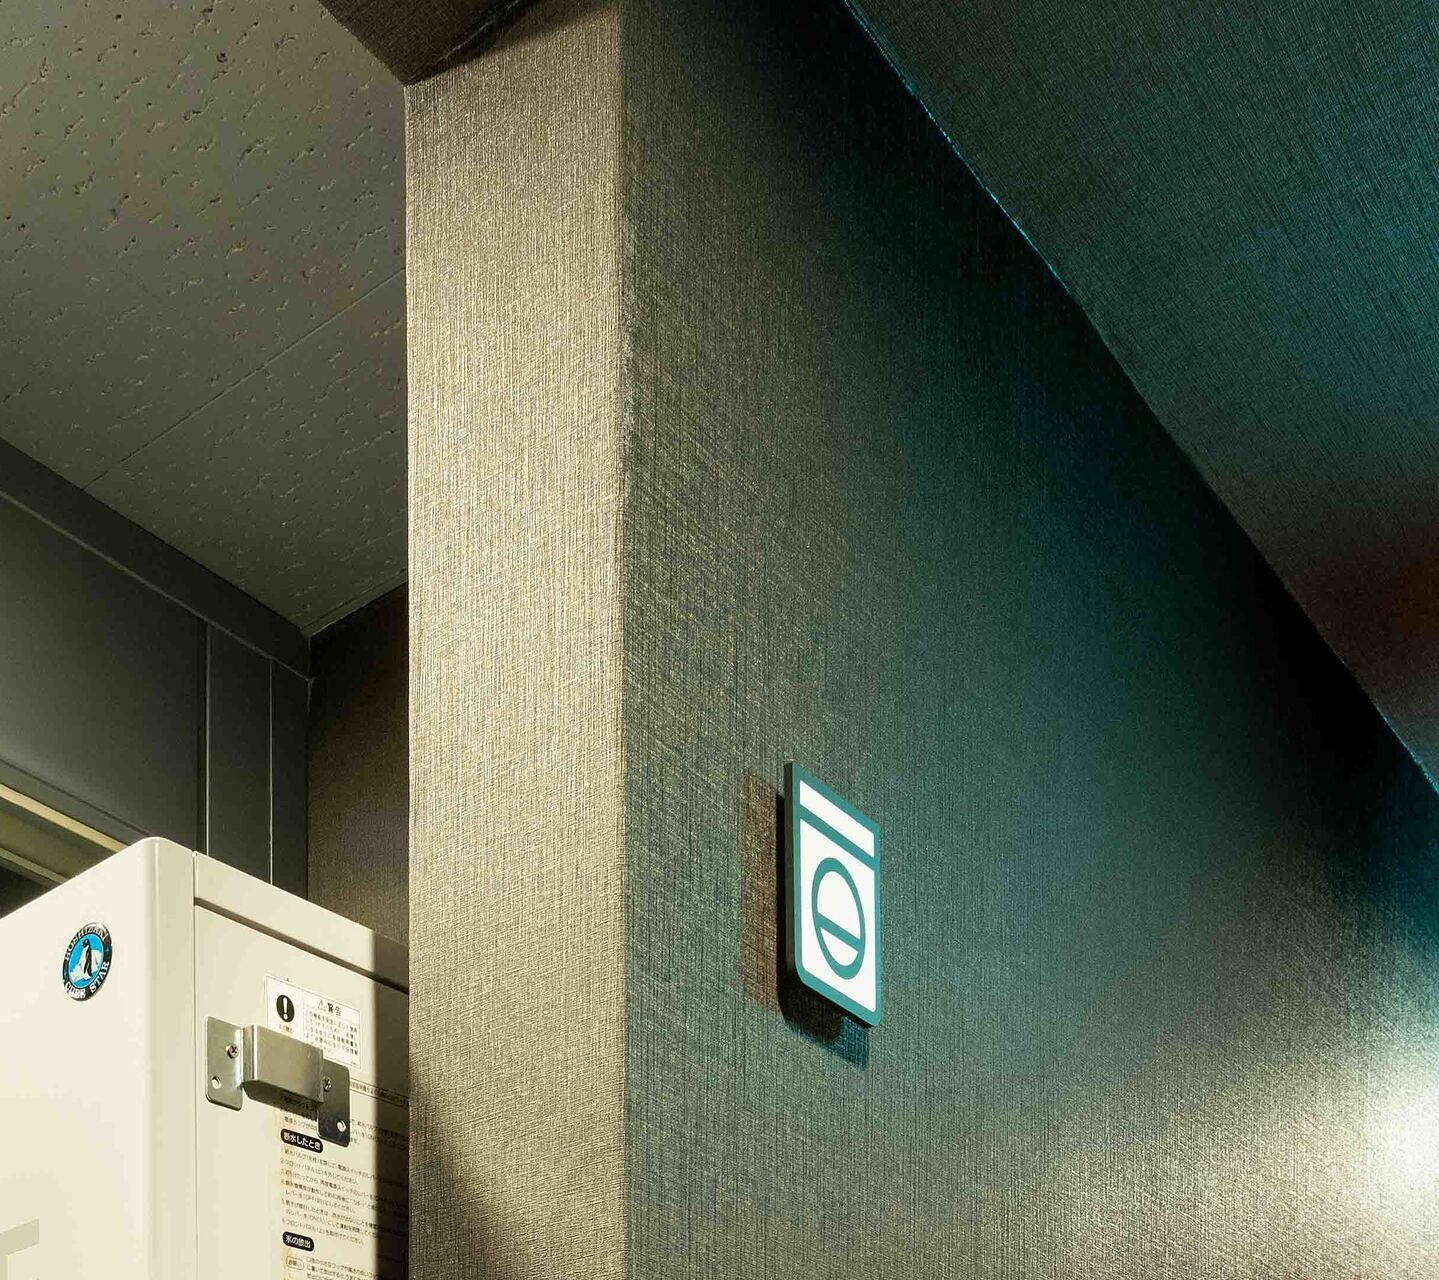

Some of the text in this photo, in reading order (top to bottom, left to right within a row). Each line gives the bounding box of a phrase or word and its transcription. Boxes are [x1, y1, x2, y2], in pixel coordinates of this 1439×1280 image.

[89, 961, 110, 994] STAR
[283, 1131, 321, 1151] 断水したとき
[285, 1234, 312, 1249] 氷の放出
